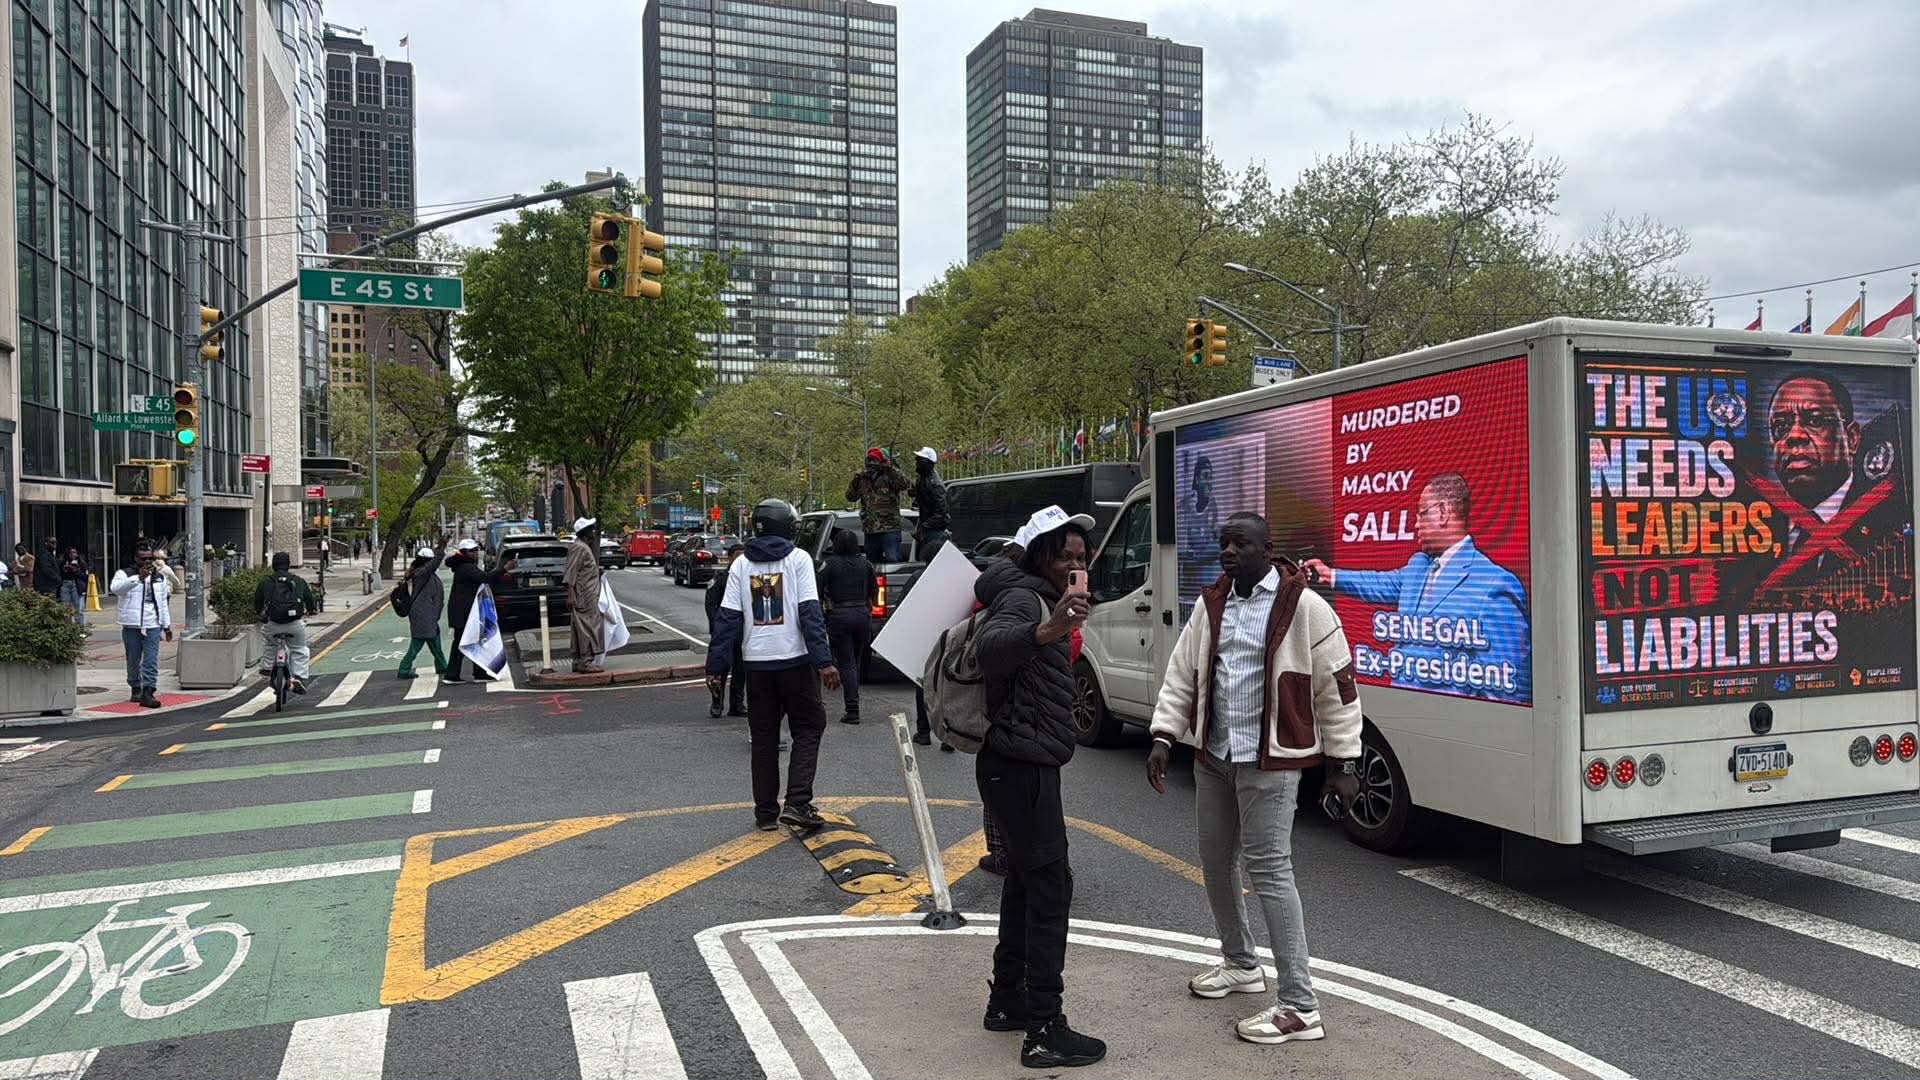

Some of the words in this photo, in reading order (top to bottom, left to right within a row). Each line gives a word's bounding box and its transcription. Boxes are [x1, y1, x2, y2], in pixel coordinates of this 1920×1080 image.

[330, 277, 346, 296] E
[356, 279, 393, 298] 45
[403, 281, 433, 301] St
[1256, 367, 1274, 375] BUSES
[145, 397, 151, 411] E
[155, 398, 170, 411] 45
[1340, 394, 1461, 434] MURDERED
[1586, 373, 1668, 429] THE
[96, 413, 121, 423] Allard
[133, 415, 175, 424] Lowenstei
[1346, 442, 1373, 465] BY
[1589, 437, 1735, 498] NEEDS
[1341, 469, 1414, 497] MACKY
[1341, 510, 1415, 542] SALL
[1590, 500, 1782, 560] LEADERS,
[1602, 566, 1693, 609] NOT
[1373, 612, 1488, 646] SENEGAL
[1594, 610, 1839, 674] LIABILITIES
[1355, 647, 1515, 690] Ex-President
[1713, 676, 1758, 688] ACCOUNTABILITY
[1867, 668, 1886, 677] PEOPLE
[1621, 684, 1633, 693] OUR
[1635, 683, 1657, 692] FUTURE
